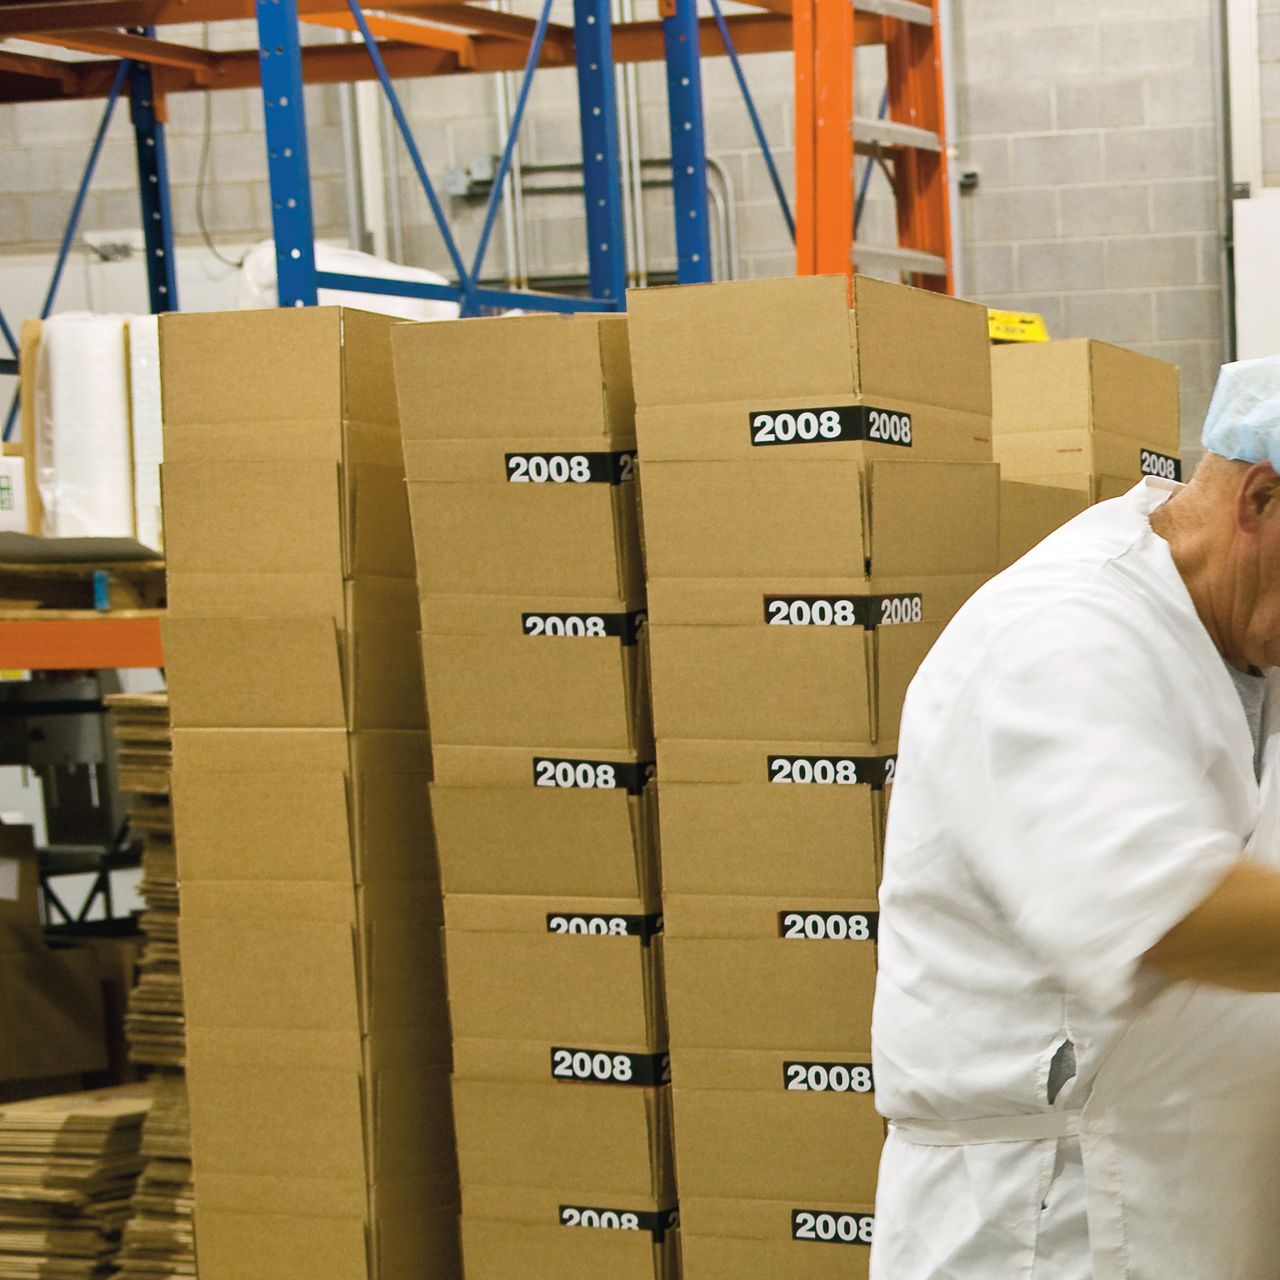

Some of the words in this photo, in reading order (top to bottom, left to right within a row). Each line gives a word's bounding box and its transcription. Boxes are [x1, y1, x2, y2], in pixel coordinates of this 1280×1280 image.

[753, 411, 842, 443] 2008
[869, 411, 911, 443] 2008
[508, 455, 591, 483] 2008
[1141, 451, 1176, 480] 2008
[768, 600, 855, 626] 2008
[881, 597, 922, 624] 2008
[525, 616, 606, 637] 2008
[536, 761, 616, 789] 2008
[771, 759, 857, 785] 2008
[784, 914, 869, 940] 2008
[554, 1050, 632, 1081] 2008
[787, 1066, 872, 1092] 2008
[796, 1213, 875, 1243] 2008
